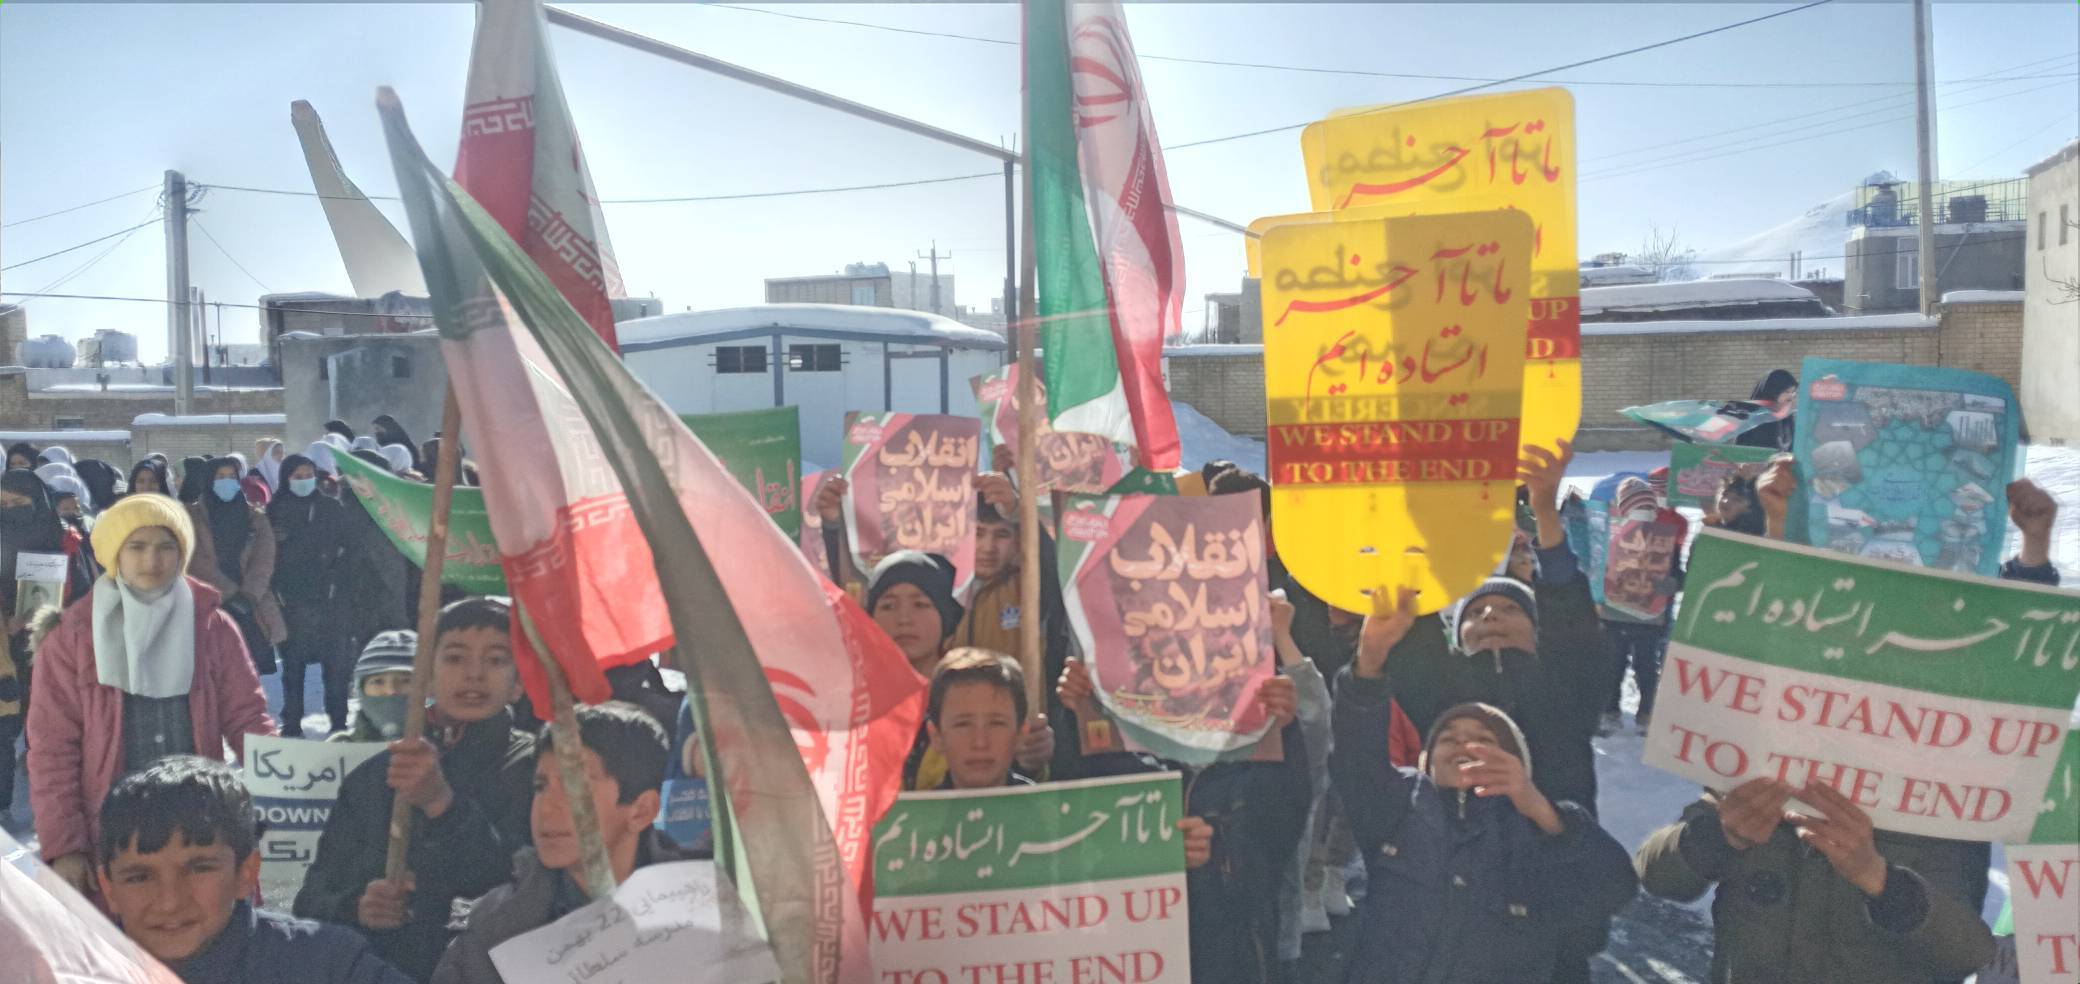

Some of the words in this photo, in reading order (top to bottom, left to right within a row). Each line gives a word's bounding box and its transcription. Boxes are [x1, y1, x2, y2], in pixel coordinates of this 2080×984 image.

[878, 429, 978, 475] انقلاب
[1278, 424, 1332, 447] WE
[1339, 421, 1453, 446] STAND
[1463, 420, 1509, 442] UP
[880, 468, 972, 512] اسلامی
[1286, 461, 1333, 483] TO
[1341, 460, 1411, 482] THE
[1418, 458, 1492, 479] END
[896, 504, 967, 547] ایران
[1109, 517, 1261, 591] انقلاب
[1123, 575, 1260, 637] اسلامی
[1152, 627, 1258, 690] ایران
[1673, 656, 1767, 715] WE
[1777, 684, 1972, 749] STAND
[1987, 716, 2060, 758] UP
[1669, 723, 1750, 779] TO
[1767, 751, 1884, 809] THE
[1892, 776, 2013, 823] END
[598, 904, 626, 931] 22
[871, 907, 946, 944] WE
[956, 894, 1110, 938] STAND
[1121, 885, 1182, 924] UP
[546, 929, 594, 965] بهمن
[960, 960, 1054, 984] THE
[1069, 949, 1164, 984] END
